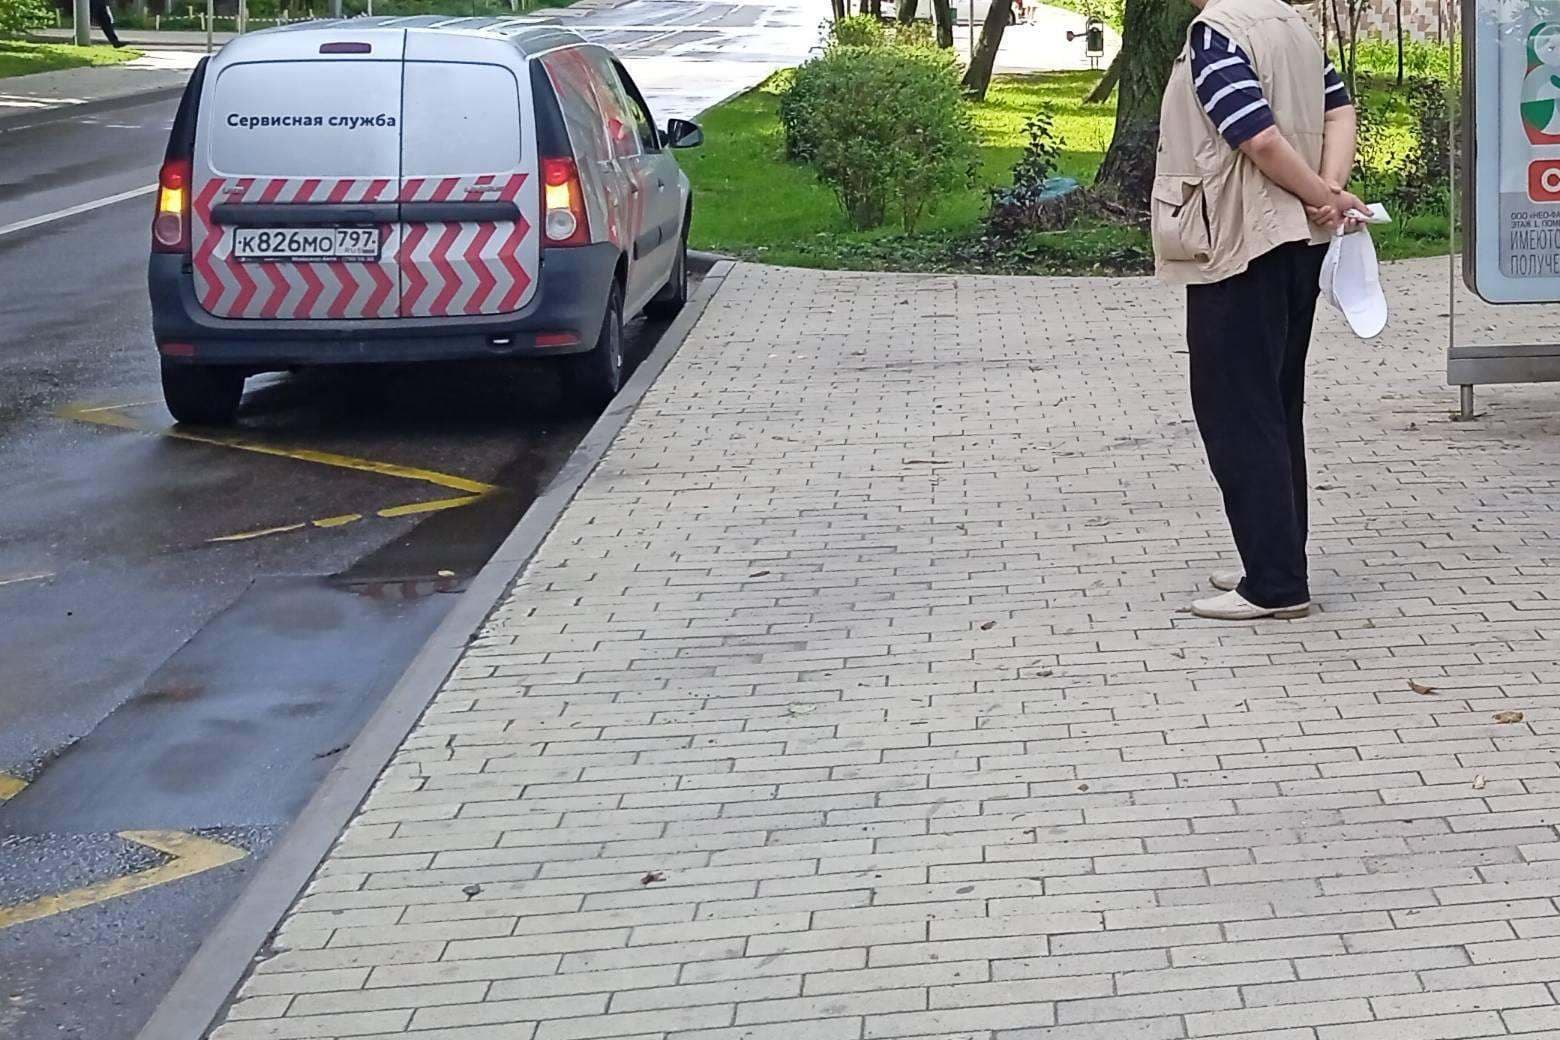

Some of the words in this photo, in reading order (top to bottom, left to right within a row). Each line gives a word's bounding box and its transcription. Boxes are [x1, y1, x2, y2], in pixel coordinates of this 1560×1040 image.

[227, 113, 323, 129] Сервисная
[328, 113, 397, 129] служба
[1511, 212, 1527, 220] ООО
[242, 231, 333, 253] К826МО
[337, 230, 372, 248] 797
